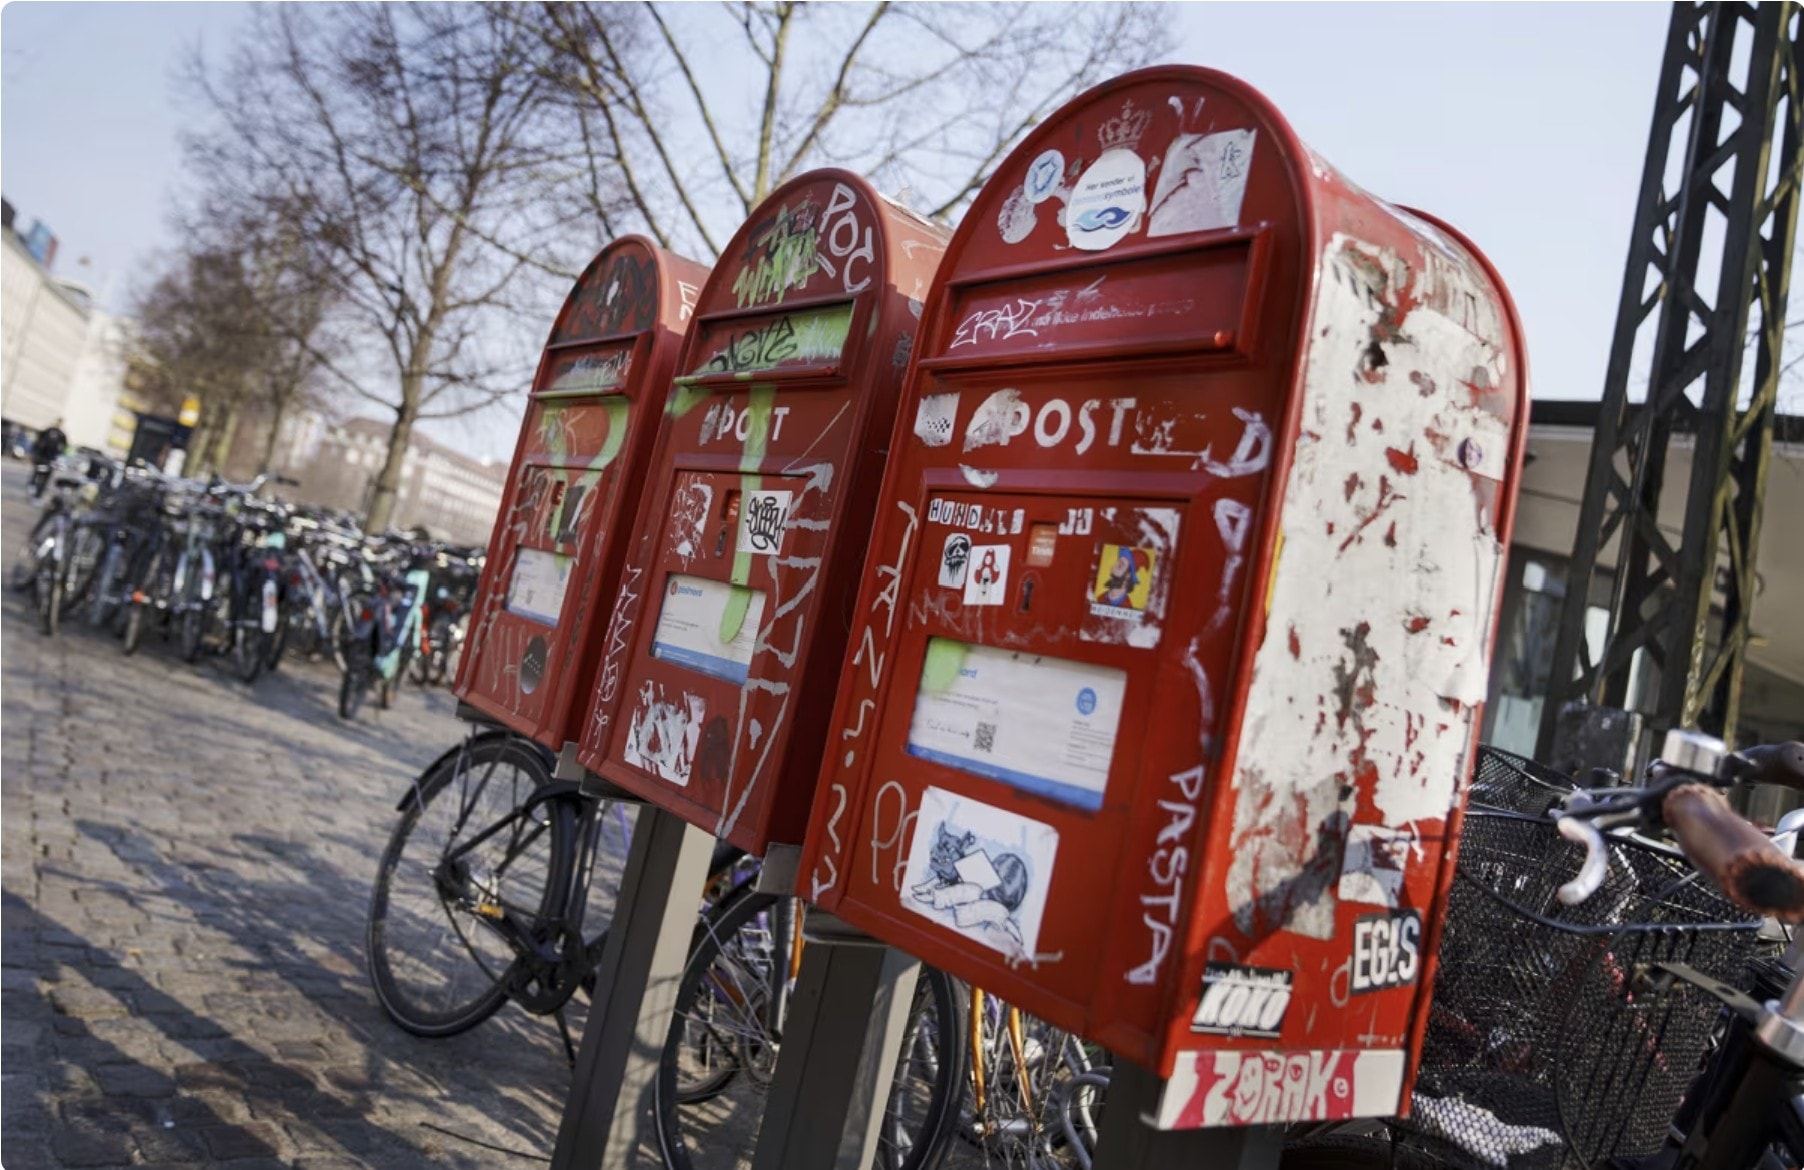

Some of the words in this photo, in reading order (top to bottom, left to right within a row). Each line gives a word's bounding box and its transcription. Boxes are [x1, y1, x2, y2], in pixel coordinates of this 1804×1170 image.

[717, 406, 790, 441] POT
[1000, 397, 1136, 456] POST
[1123, 765, 1205, 984] PASTA
[1192, 983, 1291, 1031] KOKO
